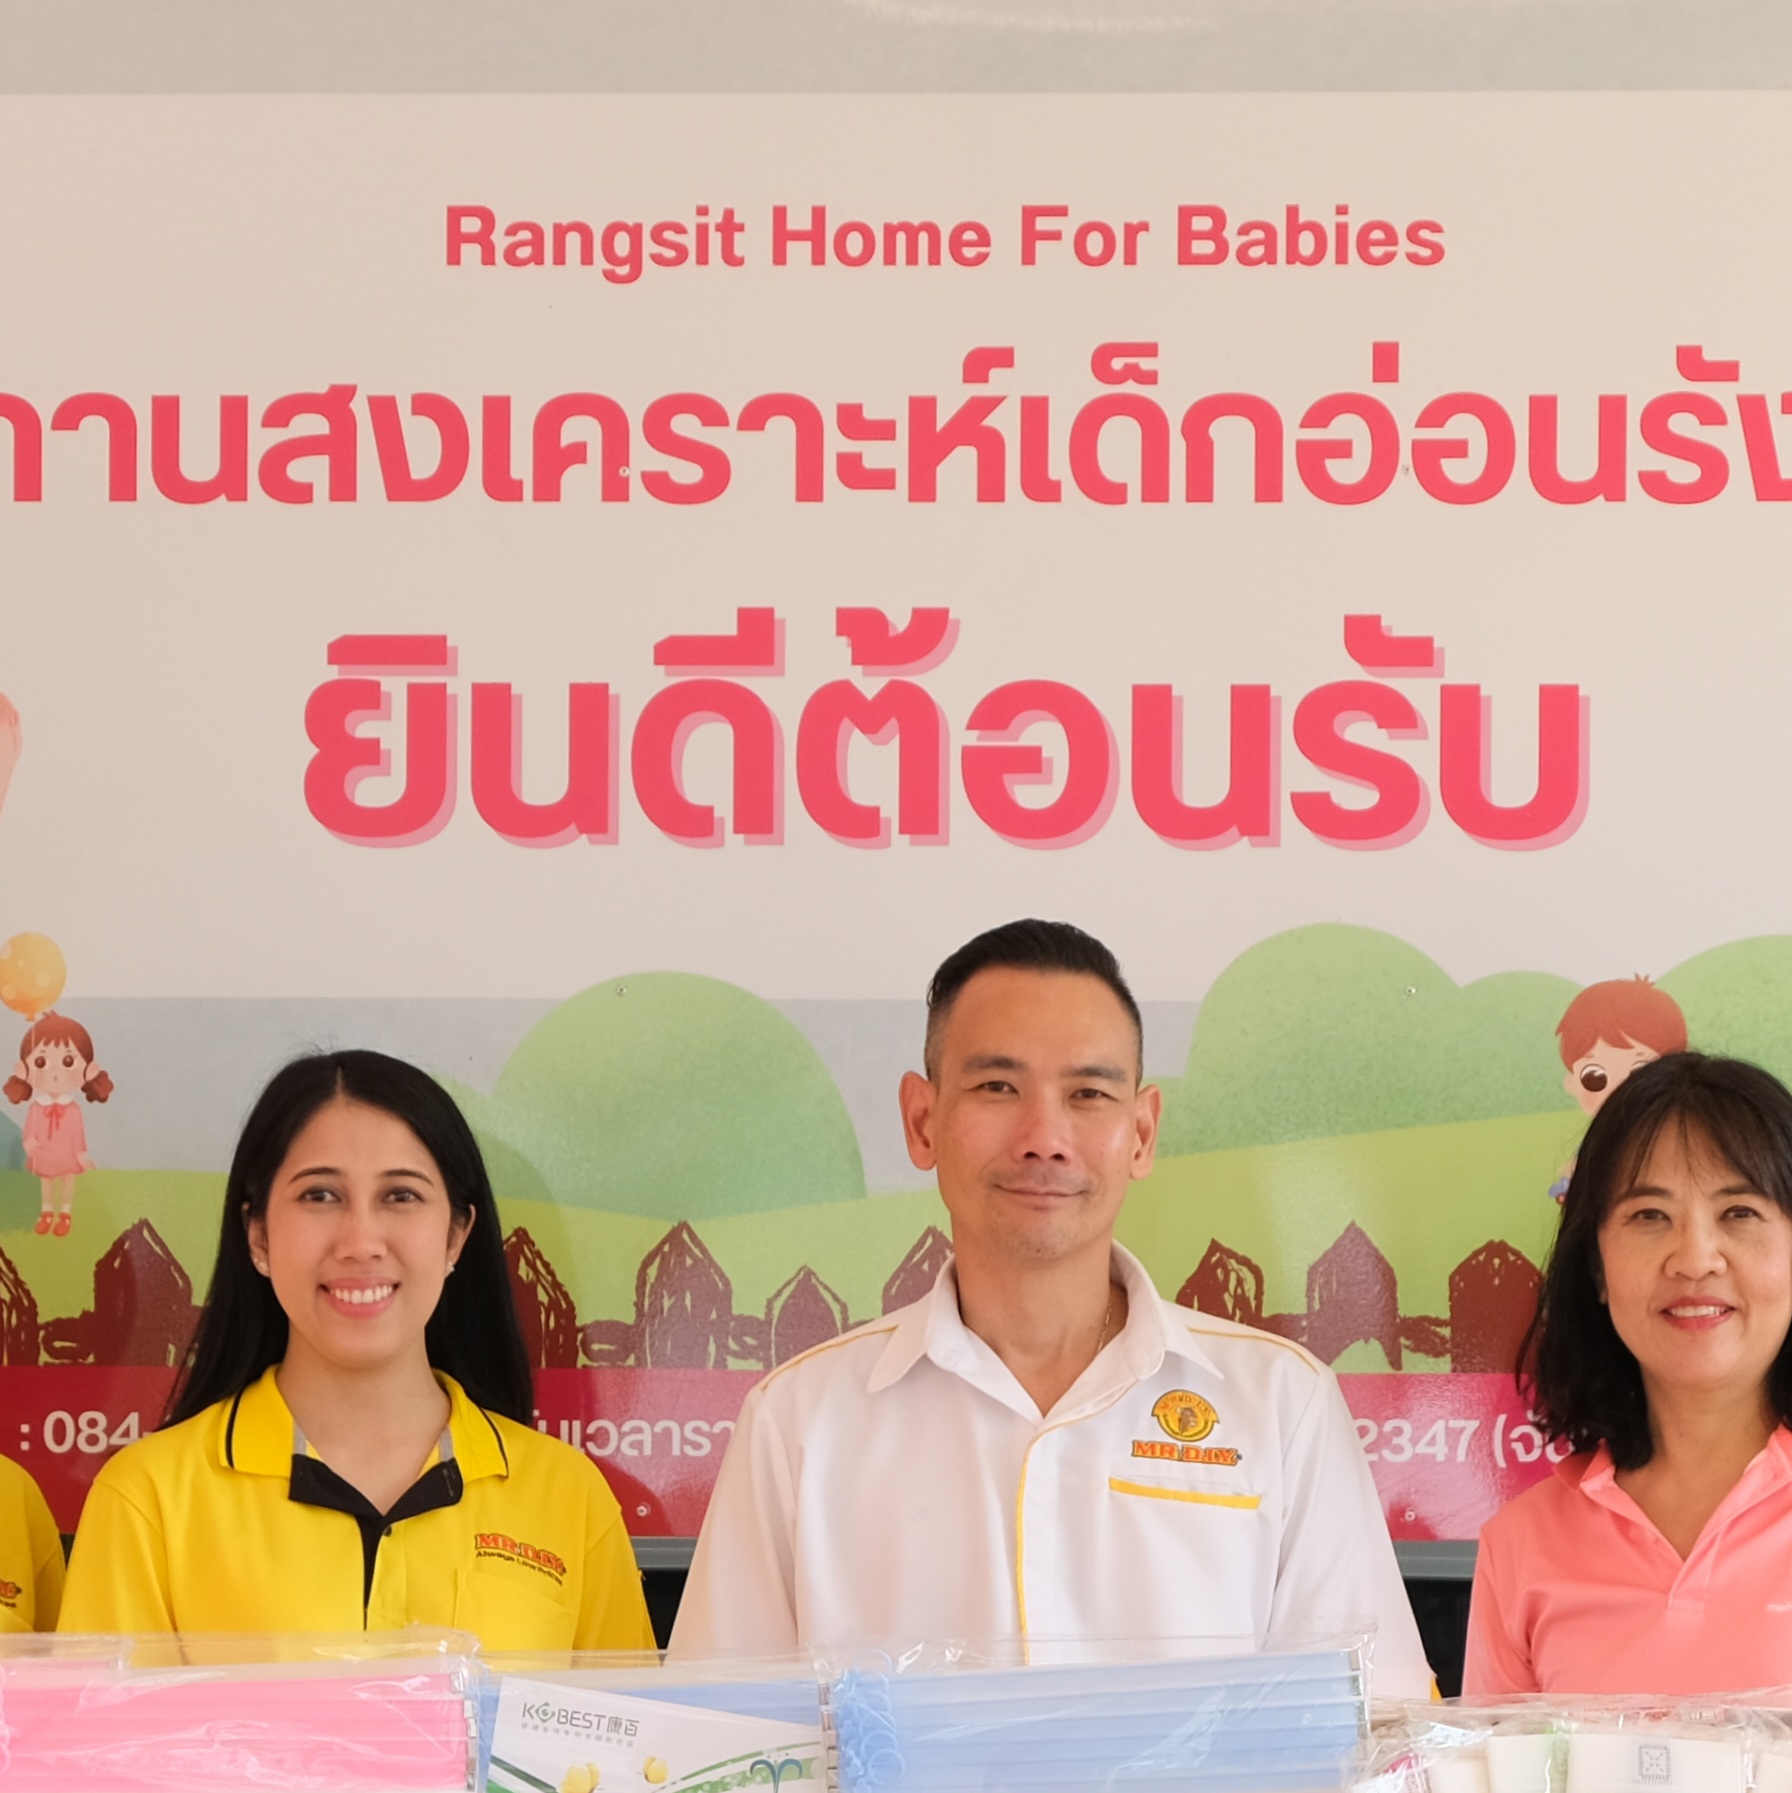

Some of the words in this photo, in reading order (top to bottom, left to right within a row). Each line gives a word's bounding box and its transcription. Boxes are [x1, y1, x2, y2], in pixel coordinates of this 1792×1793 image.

[442, 203, 745, 285] Rangsit
[770, 205, 993, 267] Home
[1019, 206, 1149, 267] For
[1173, 203, 1444, 267] Babies
[300, 607, 1589, 847] ยินดีต้อนรับ
